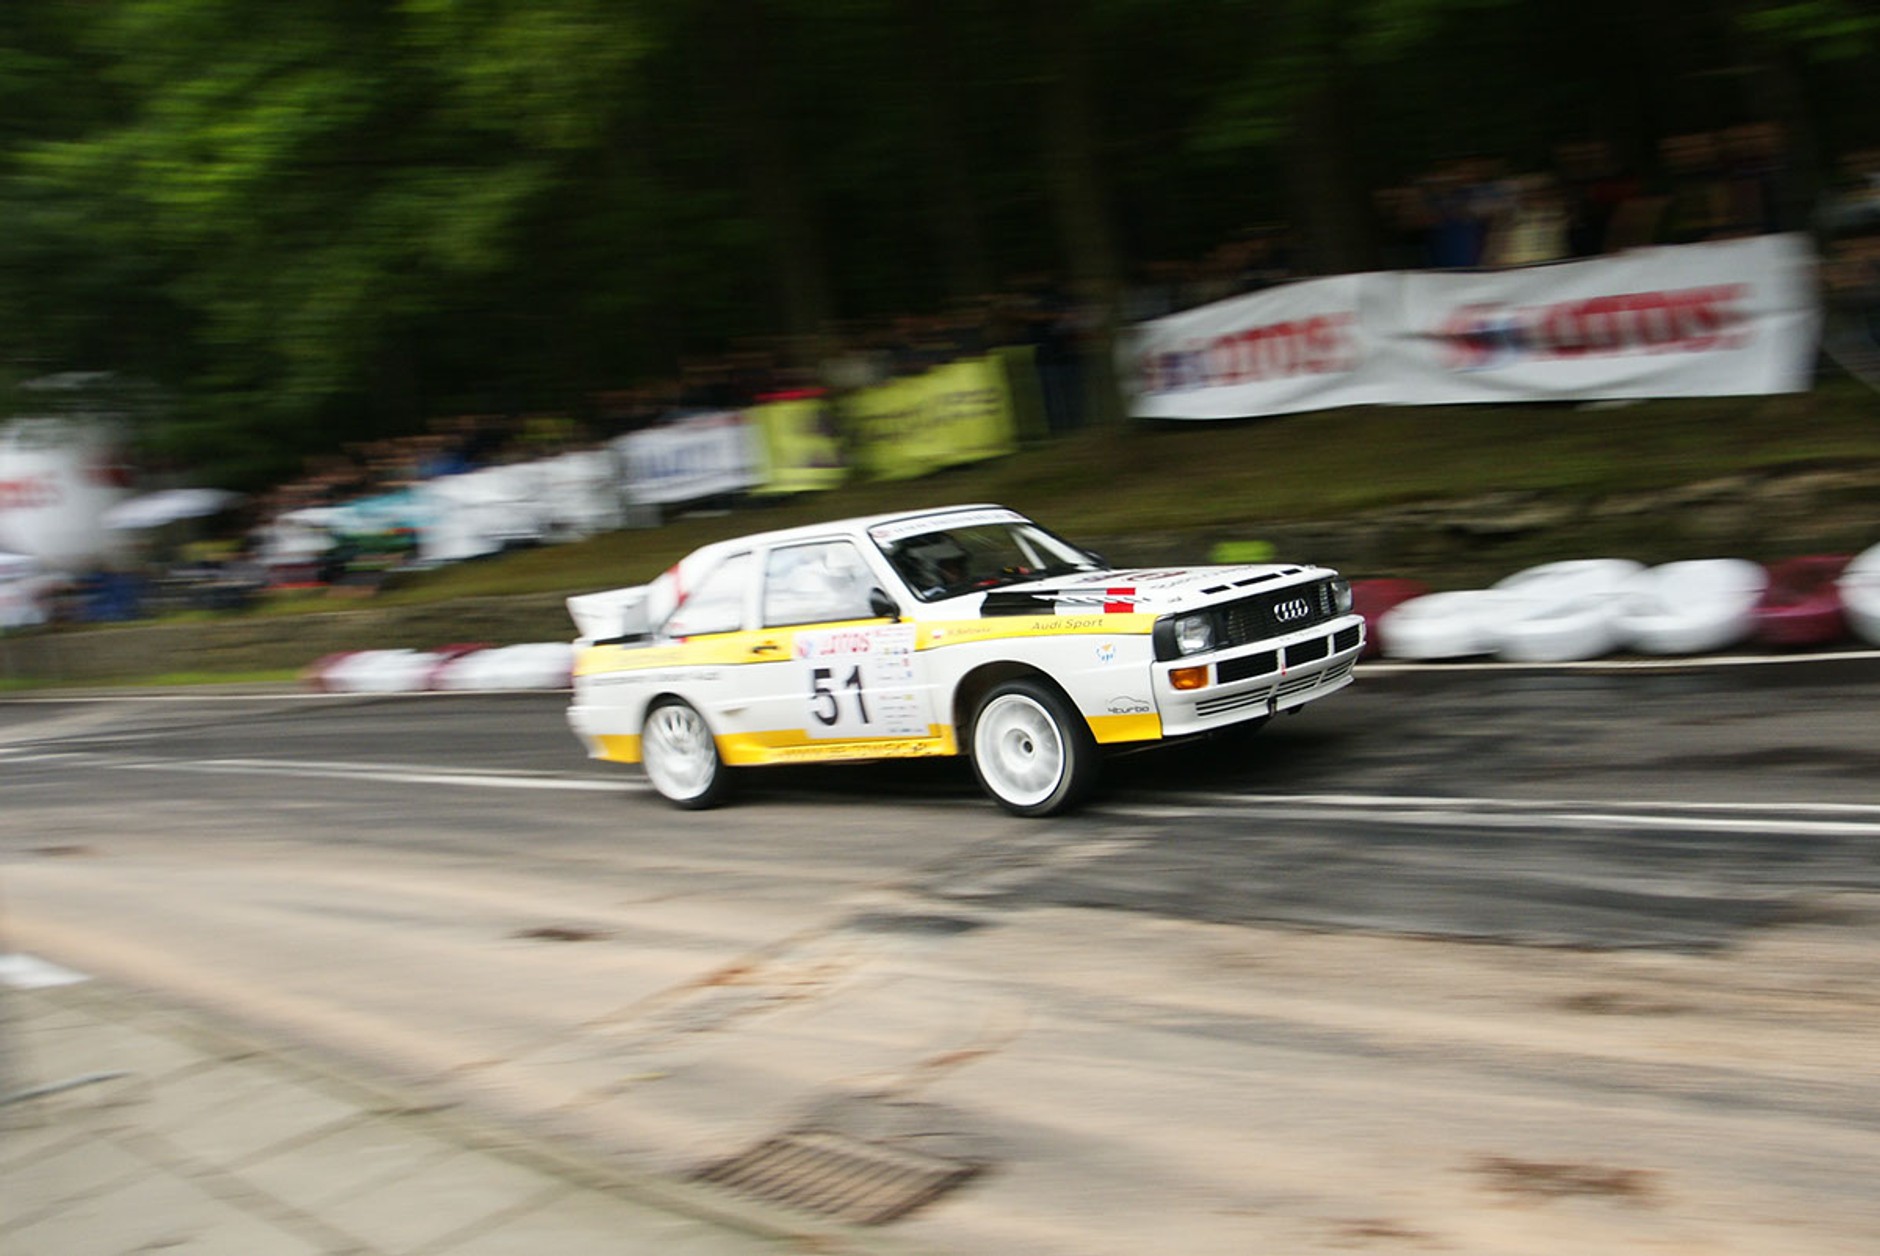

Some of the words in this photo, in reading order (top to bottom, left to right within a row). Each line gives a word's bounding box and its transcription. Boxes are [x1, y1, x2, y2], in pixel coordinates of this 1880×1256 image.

[1031, 620, 1062, 632] Audi
[1065, 618, 1104, 631] Sport
[809, 664, 871, 727] 51
